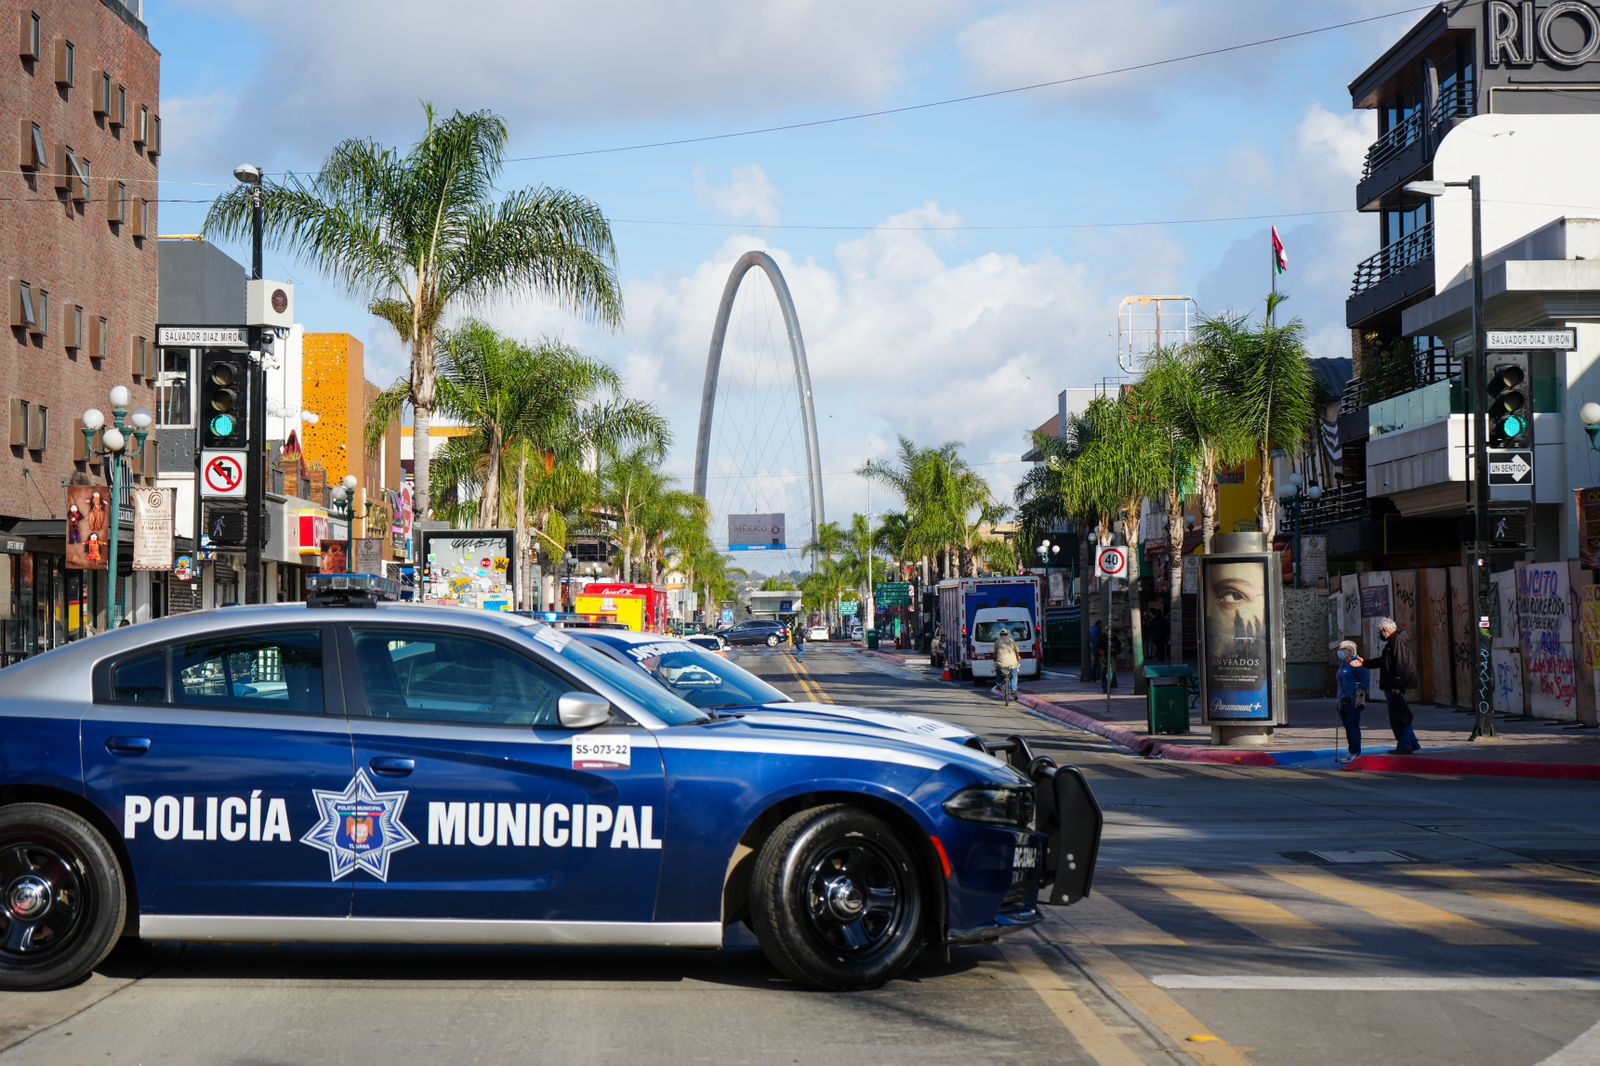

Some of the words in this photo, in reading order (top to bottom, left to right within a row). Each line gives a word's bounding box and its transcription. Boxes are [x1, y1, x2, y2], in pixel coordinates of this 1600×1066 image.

[1488, 0, 1600, 65] RIO
[165, 332, 200, 341] SALVADOR
[203, 332, 218, 342] DIAZ
[221, 332, 242, 342] MIRON
[1491, 335, 1526, 345] SALVADOR
[1530, 335, 1545, 345] DIAZ
[1548, 335, 1570, 345] MIRON
[1491, 464, 1500, 472] UN
[1501, 464, 1526, 472] SENTIDO
[1105, 554, 1118, 566] 40
[1213, 658, 1260, 667] NVIADOS
[1212, 698, 1262, 712] Paramount+
[576, 744, 627, 755] SS-073-22
[124, 790, 292, 842] POLICÍA
[428, 801, 663, 850] MUNICIPAL
